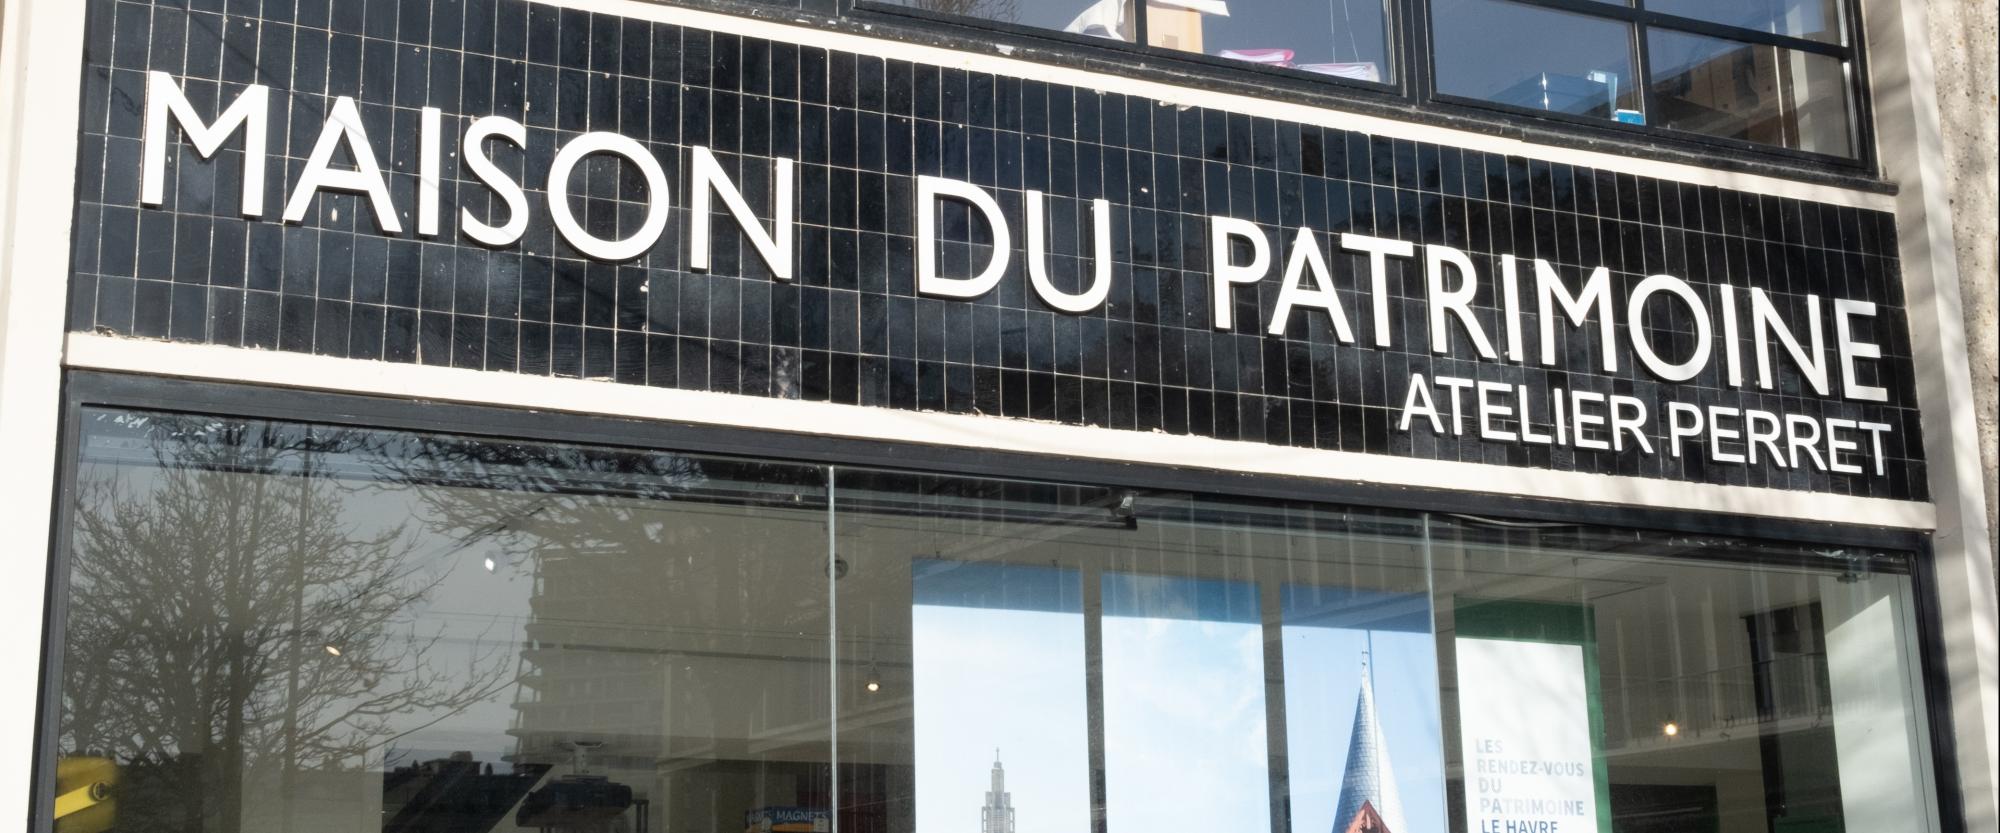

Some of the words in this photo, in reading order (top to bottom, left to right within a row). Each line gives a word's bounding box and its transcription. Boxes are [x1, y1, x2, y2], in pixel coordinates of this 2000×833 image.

[140, 70, 794, 281] MAISON
[917, 174, 1111, 313] DU
[1210, 215, 1888, 402] PATRIMOINE
[1400, 373, 1654, 454] ATELIER
[1669, 402, 1892, 477] PERRET
[1475, 738, 1504, 754] LES
[1477, 759, 1585, 777] RENDEZ-VOUS
[1478, 777, 1502, 793] DU
[1479, 798, 1585, 816] PATRIMOINE
[1481, 819, 1501, 833] LE
[1506, 820, 1559, 833] HAVRE
